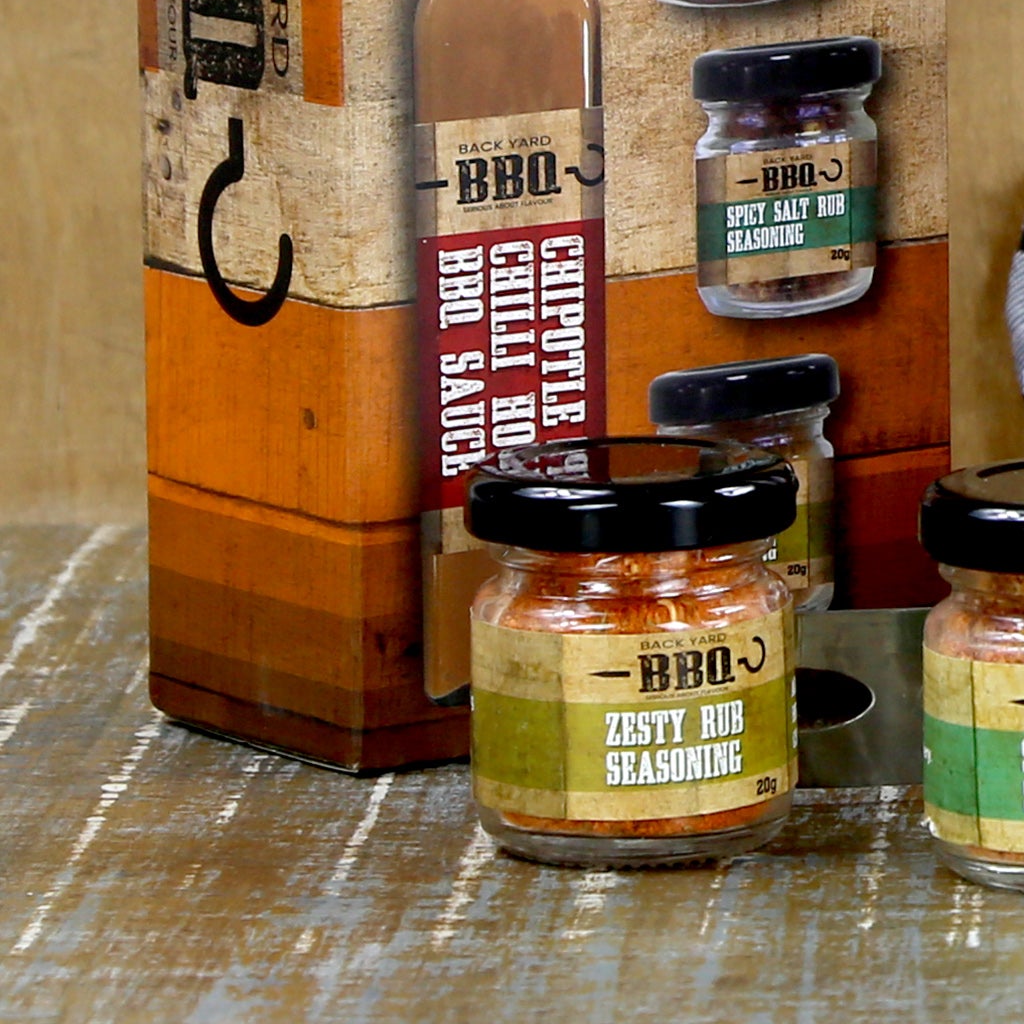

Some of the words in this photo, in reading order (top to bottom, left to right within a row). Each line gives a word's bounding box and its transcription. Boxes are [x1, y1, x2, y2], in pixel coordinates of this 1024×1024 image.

[458, 140, 504, 154] BACK
[508, 136, 552, 149] YARD
[455, 151, 562, 205] BBQ
[761, 162, 818, 192] BBQ
[726, 202, 766, 228] SPICY
[773, 197, 810, 223] SALT
[817, 193, 846, 217] RUB
[726, 223, 805, 254] SEASONING
[830, 248, 851, 261] 20g
[438, 245, 485, 330] BBQ
[489, 239, 536, 372] CHILLI
[539, 234, 586, 427] CHIPOTLE
[440, 350, 486, 477] SAUCE
[491, 392, 537, 447] HO
[786, 564, 807, 576] 20g
[640, 639, 685, 651] BACK
[689, 632, 727, 646] YARD
[637, 646, 736, 692] BBQ
[604, 708, 687, 747] ZESTY
[699, 699, 745, 741] RUB
[605, 739, 743, 786] SEASONING
[756, 776, 778, 796] 20g
